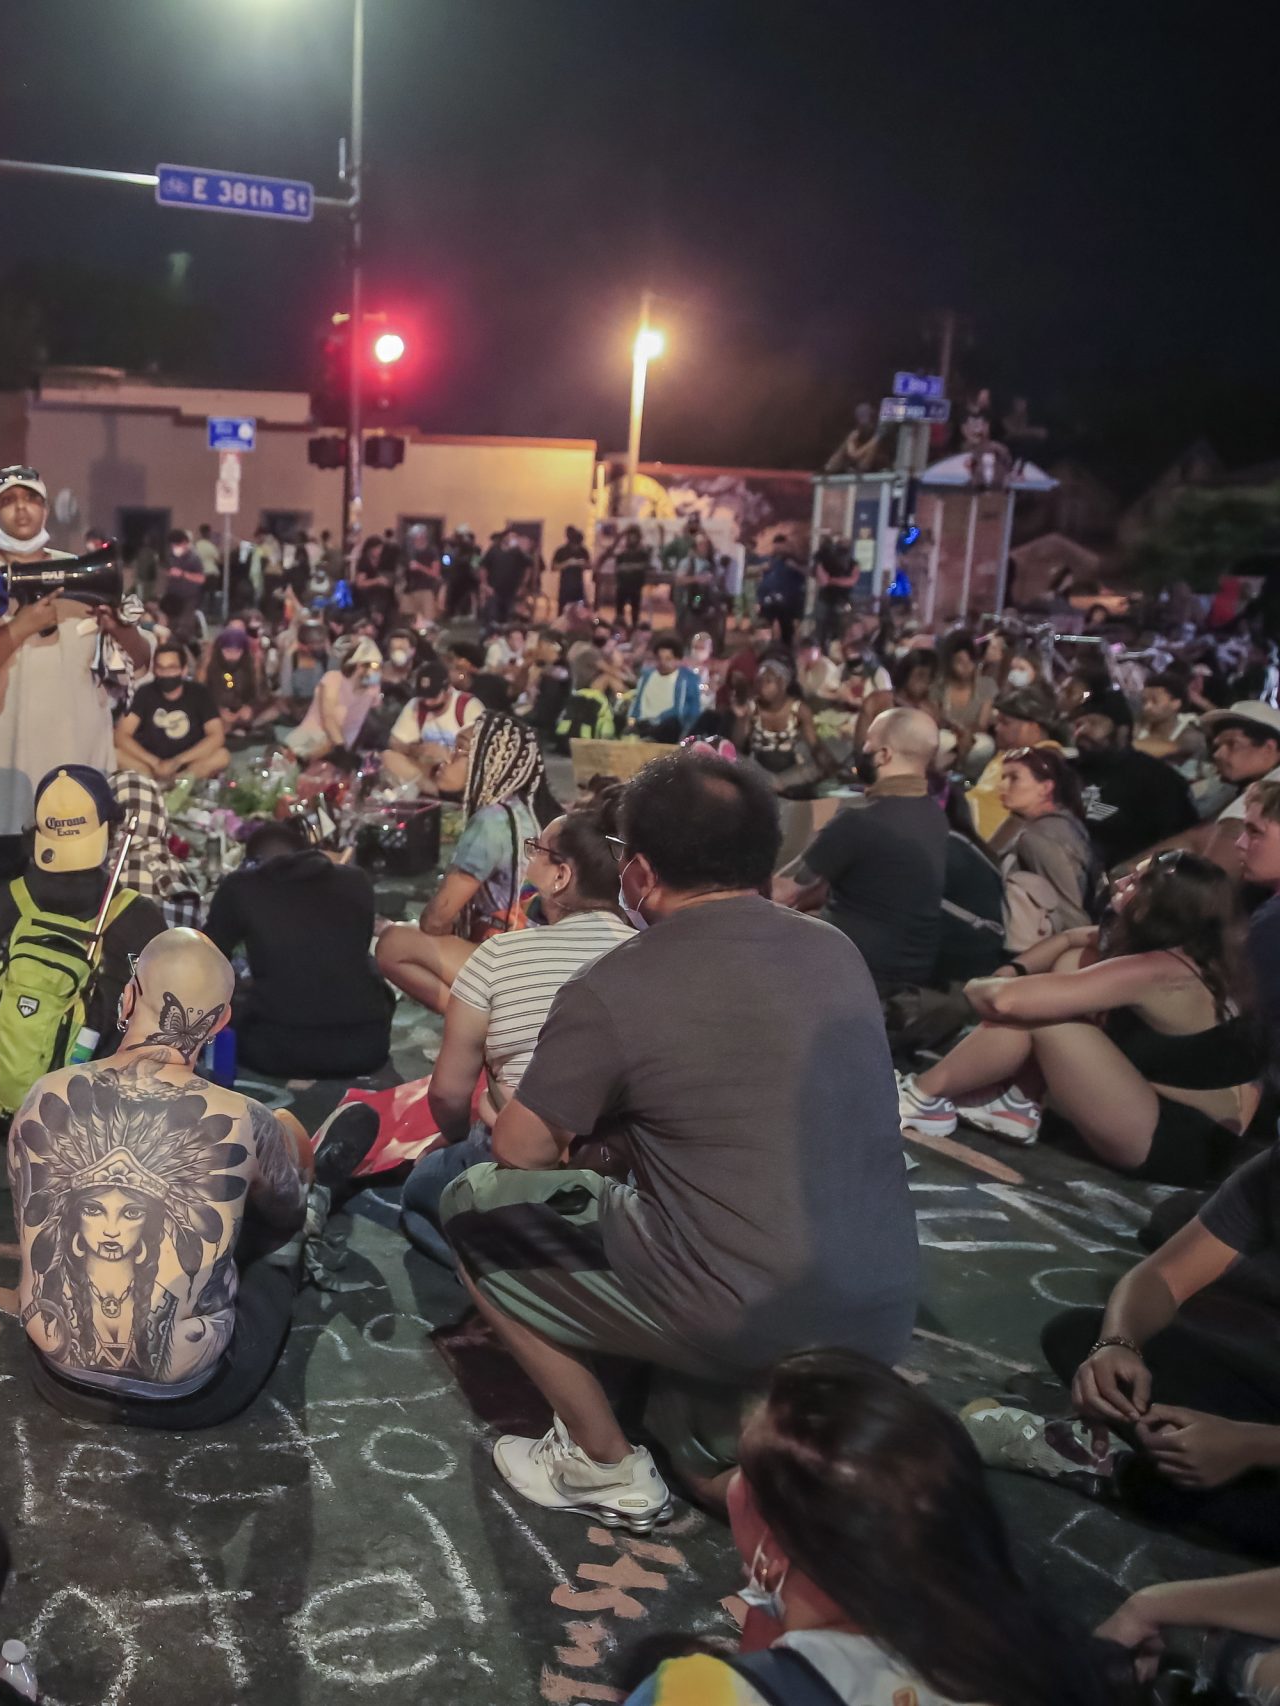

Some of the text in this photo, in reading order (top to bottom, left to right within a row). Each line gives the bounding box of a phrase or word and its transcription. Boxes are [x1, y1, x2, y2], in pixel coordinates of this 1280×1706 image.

[192, 176, 308, 213] E 38th St
[45, 816, 87, 829] Corona
